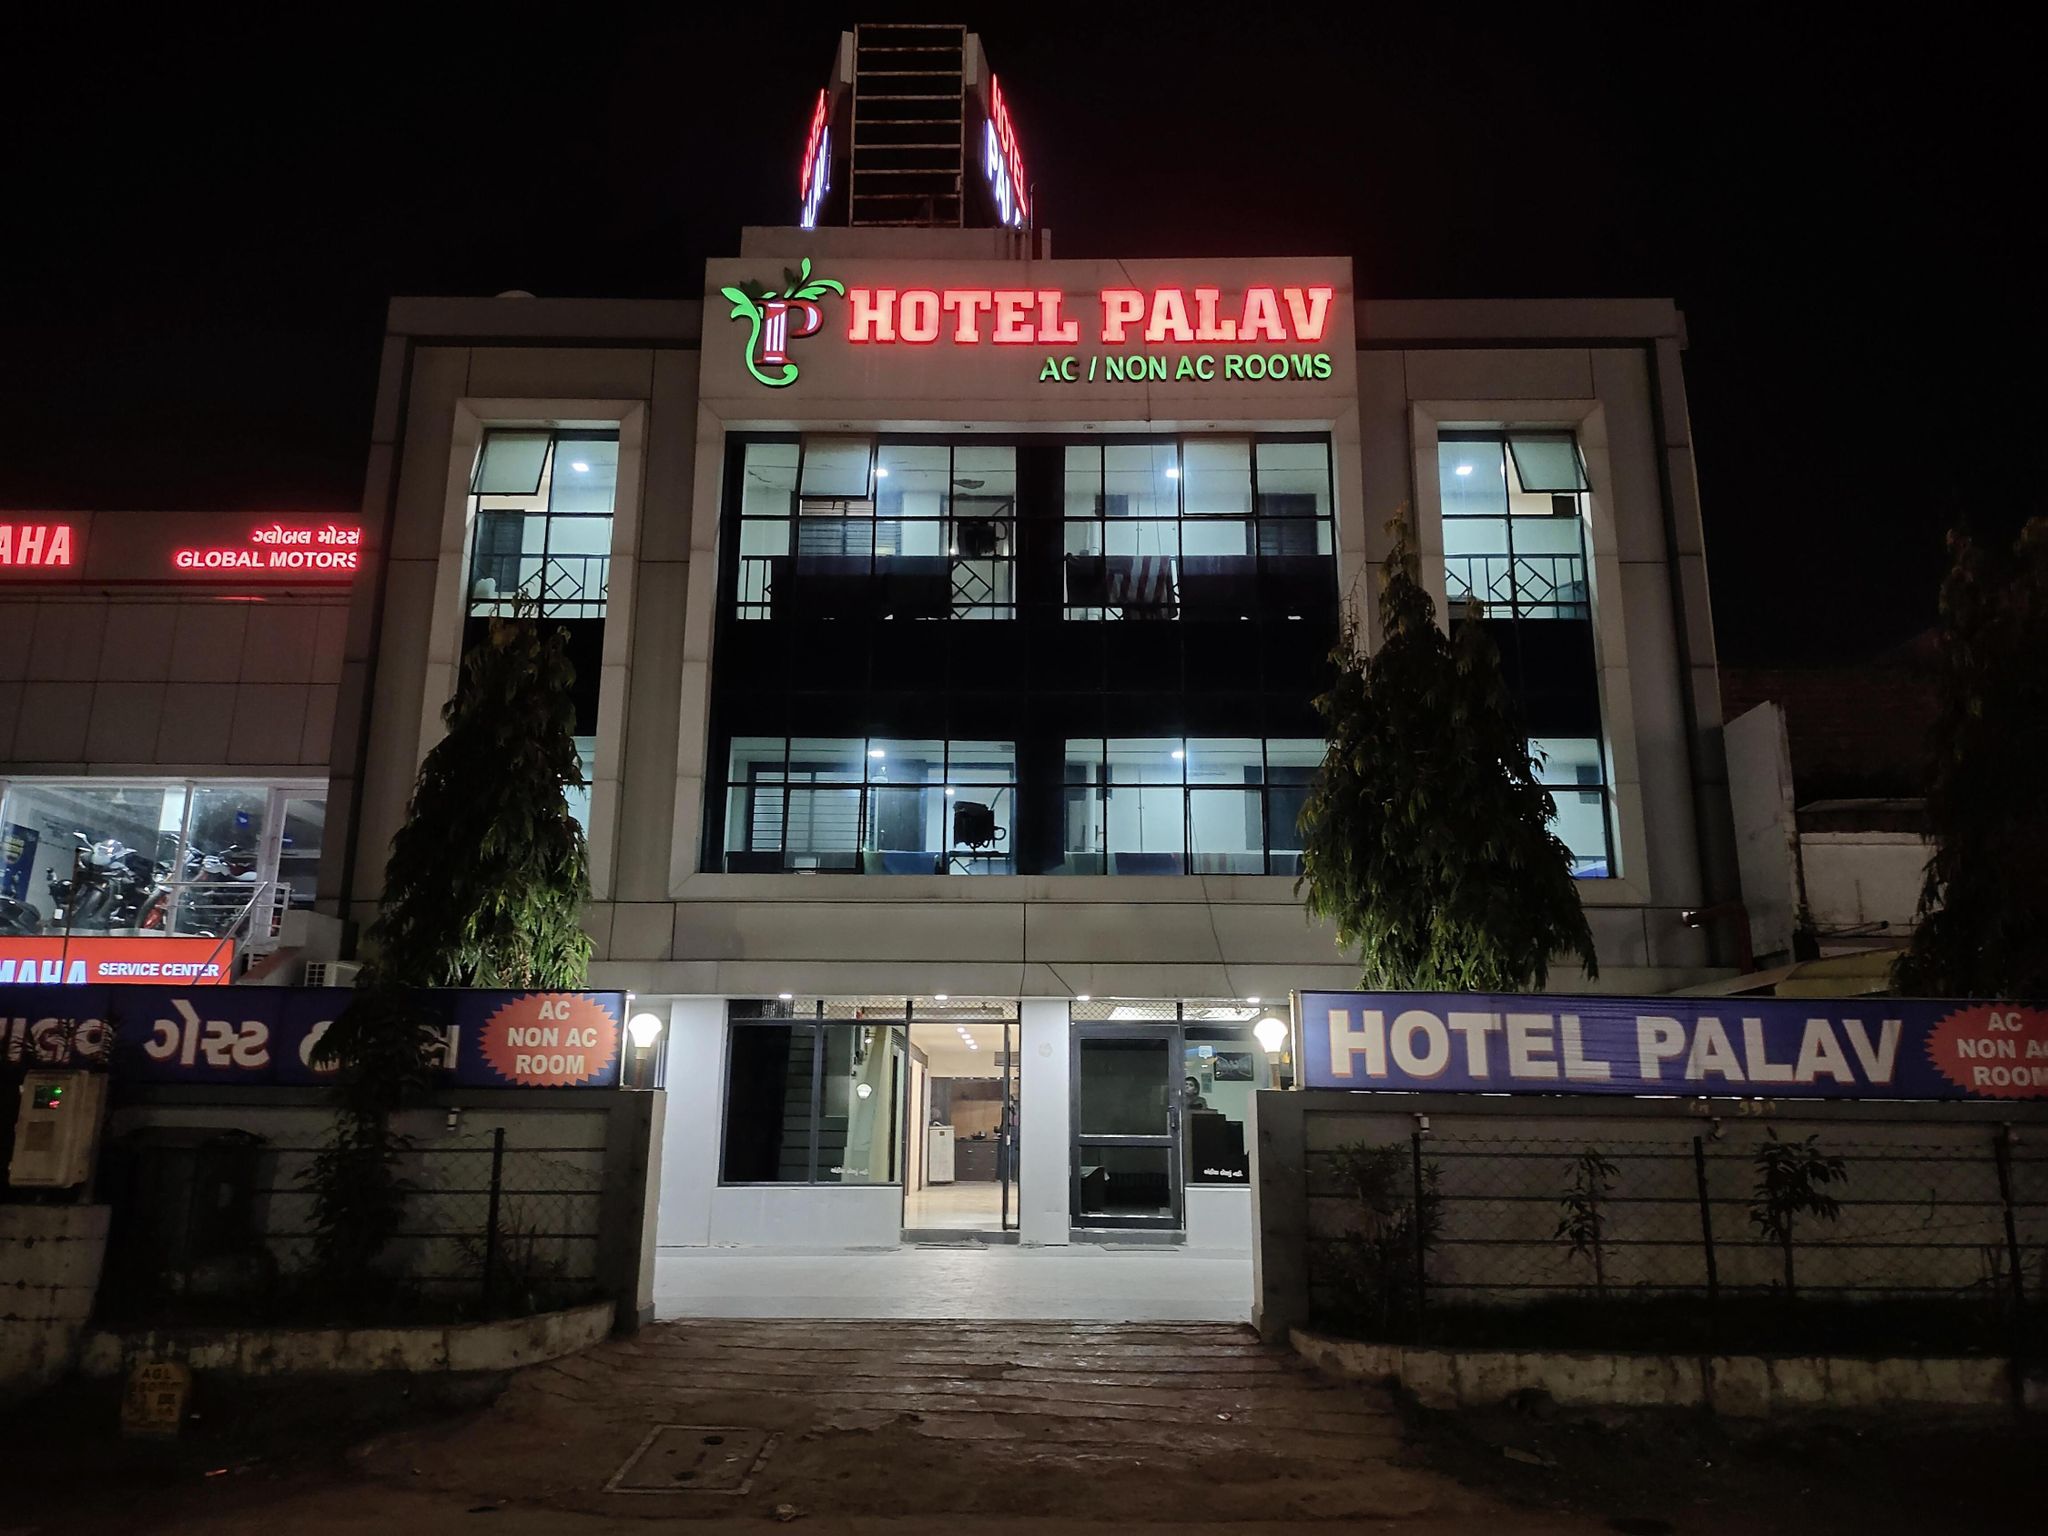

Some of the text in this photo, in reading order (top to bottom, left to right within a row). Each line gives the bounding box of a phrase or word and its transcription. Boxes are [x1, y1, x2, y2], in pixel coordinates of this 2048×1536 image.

[992, 73, 1027, 216] HOTEL
[849, 288, 1333, 344] HOTEL PALAV
[1039, 356, 1080, 381] AC
[1106, 355, 1168, 382] NON
[1175, 355, 1216, 381] AC
[1225, 353, 1333, 381] ROOMS
[176, 551, 265, 568] GLOBAL
[98, 963, 159, 977] SERVICE
[164, 964, 219, 977] CENTER
[538, 1000, 571, 1020] AC
[1988, 1012, 2023, 1032] AC
[144, 999, 270, 1067] ગેસ્ટ
[507, 1027, 597, 1048] NON AC
[1328, 1009, 1902, 1084] HOTEL PALAV
[1957, 1038, 2016, 1059] NON
[515, 1054, 585, 1075] ROOM
